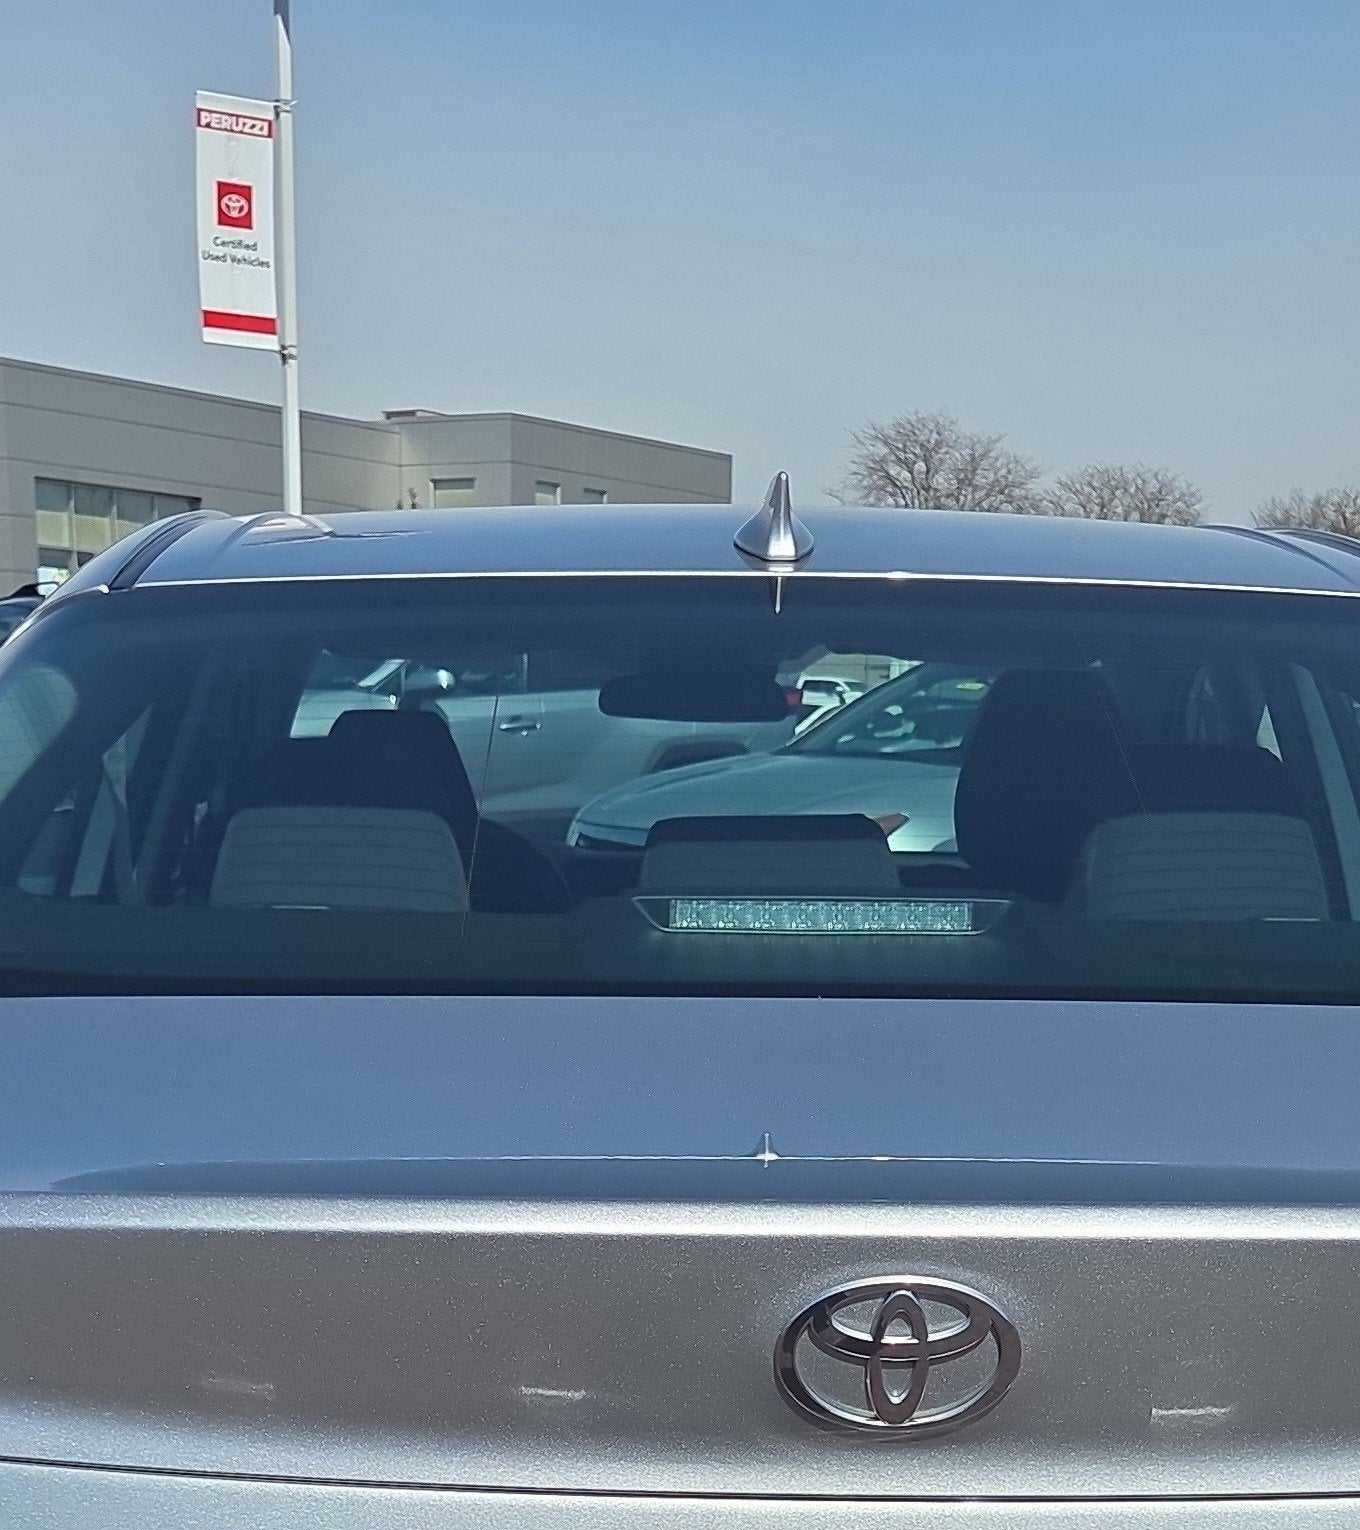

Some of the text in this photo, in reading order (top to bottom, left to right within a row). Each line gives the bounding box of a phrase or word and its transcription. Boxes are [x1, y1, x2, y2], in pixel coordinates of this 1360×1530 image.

[200, 111, 269, 136] PERUZZI
[213, 236, 258, 252] Certified
[201, 250, 271, 269] Used Vehicles
